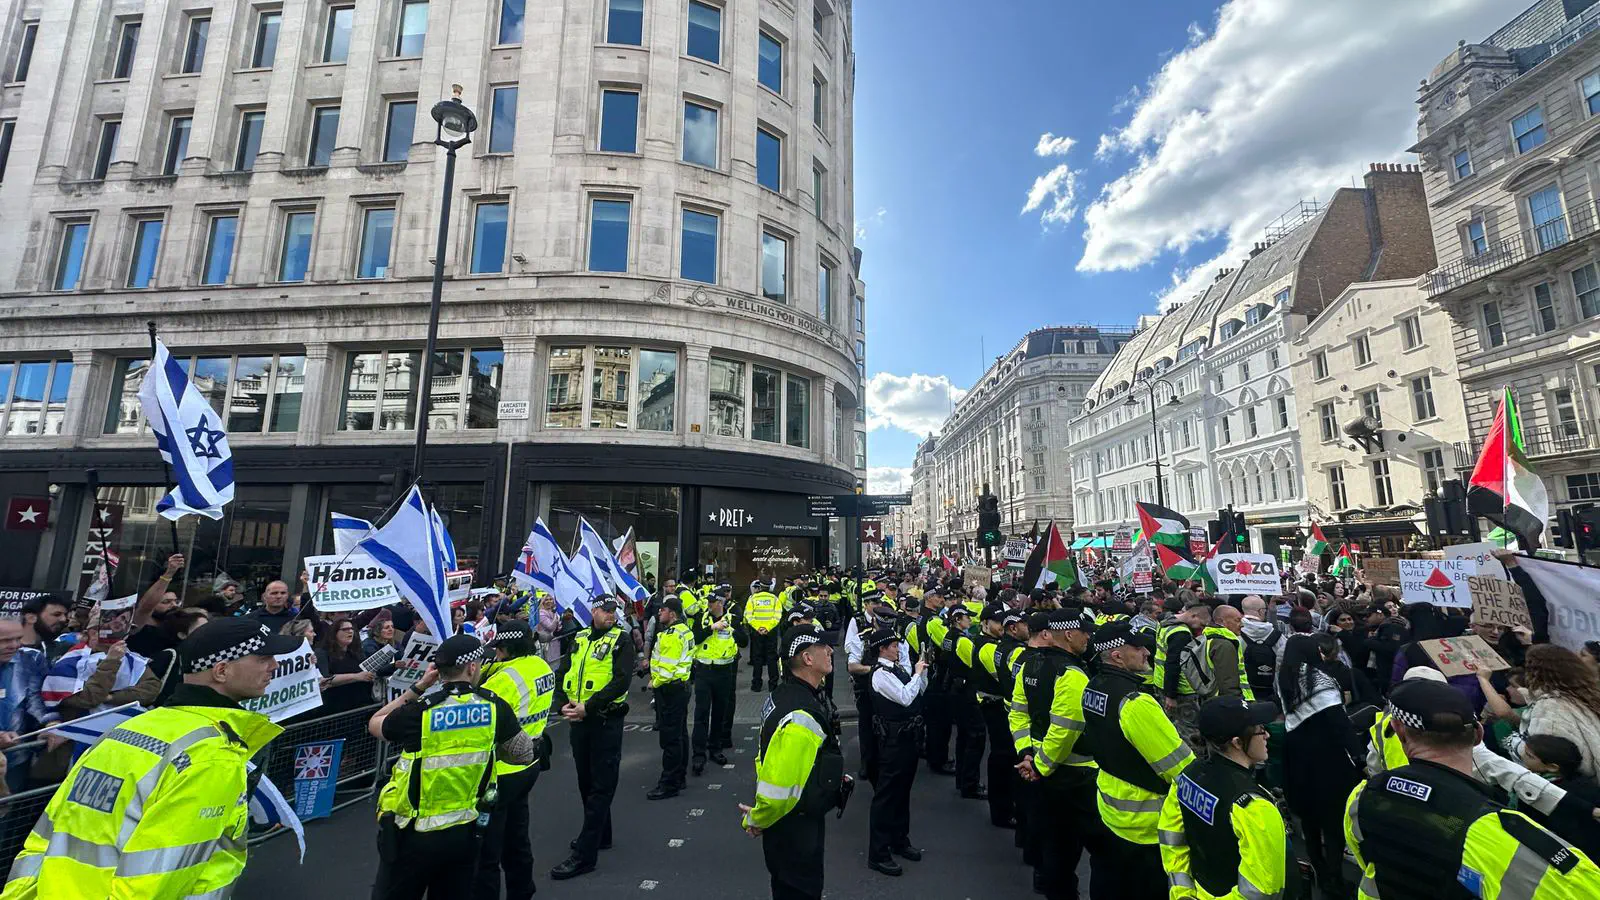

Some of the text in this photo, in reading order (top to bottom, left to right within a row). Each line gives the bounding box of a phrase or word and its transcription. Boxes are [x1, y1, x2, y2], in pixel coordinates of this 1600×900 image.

[726, 297, 824, 336] WELLINGTON HOUSE
[720, 508, 744, 528] PRET
[1008, 548, 1025, 558] NOW!
[1218, 558, 1275, 575] Gza
[1402, 560, 1463, 570] PALESTINE
[312, 566, 386, 583] Hamas
[1454, 573, 1468, 581] BE
[1404, 581, 1424, 591] FREE
[1468, 576, 1502, 592] SHUT
[0, 591, 19, 600] FOR
[313, 585, 392, 601] TERRORIST
[1472, 592, 1503, 608] THE
[536, 675, 554, 694] POLICE
[1024, 677, 1038, 686] POLICE
[240, 678, 316, 711] TERRORIST
[1084, 691, 1105, 712] OLICE
[434, 708, 490, 727] POLICE
[1390, 778, 1426, 797] POLICE
[305, 780, 319, 815] OCTOBER
[1178, 778, 1213, 819] POLICE
[200, 805, 225, 818] POLICE
[1551, 848, 1569, 866] 5637
